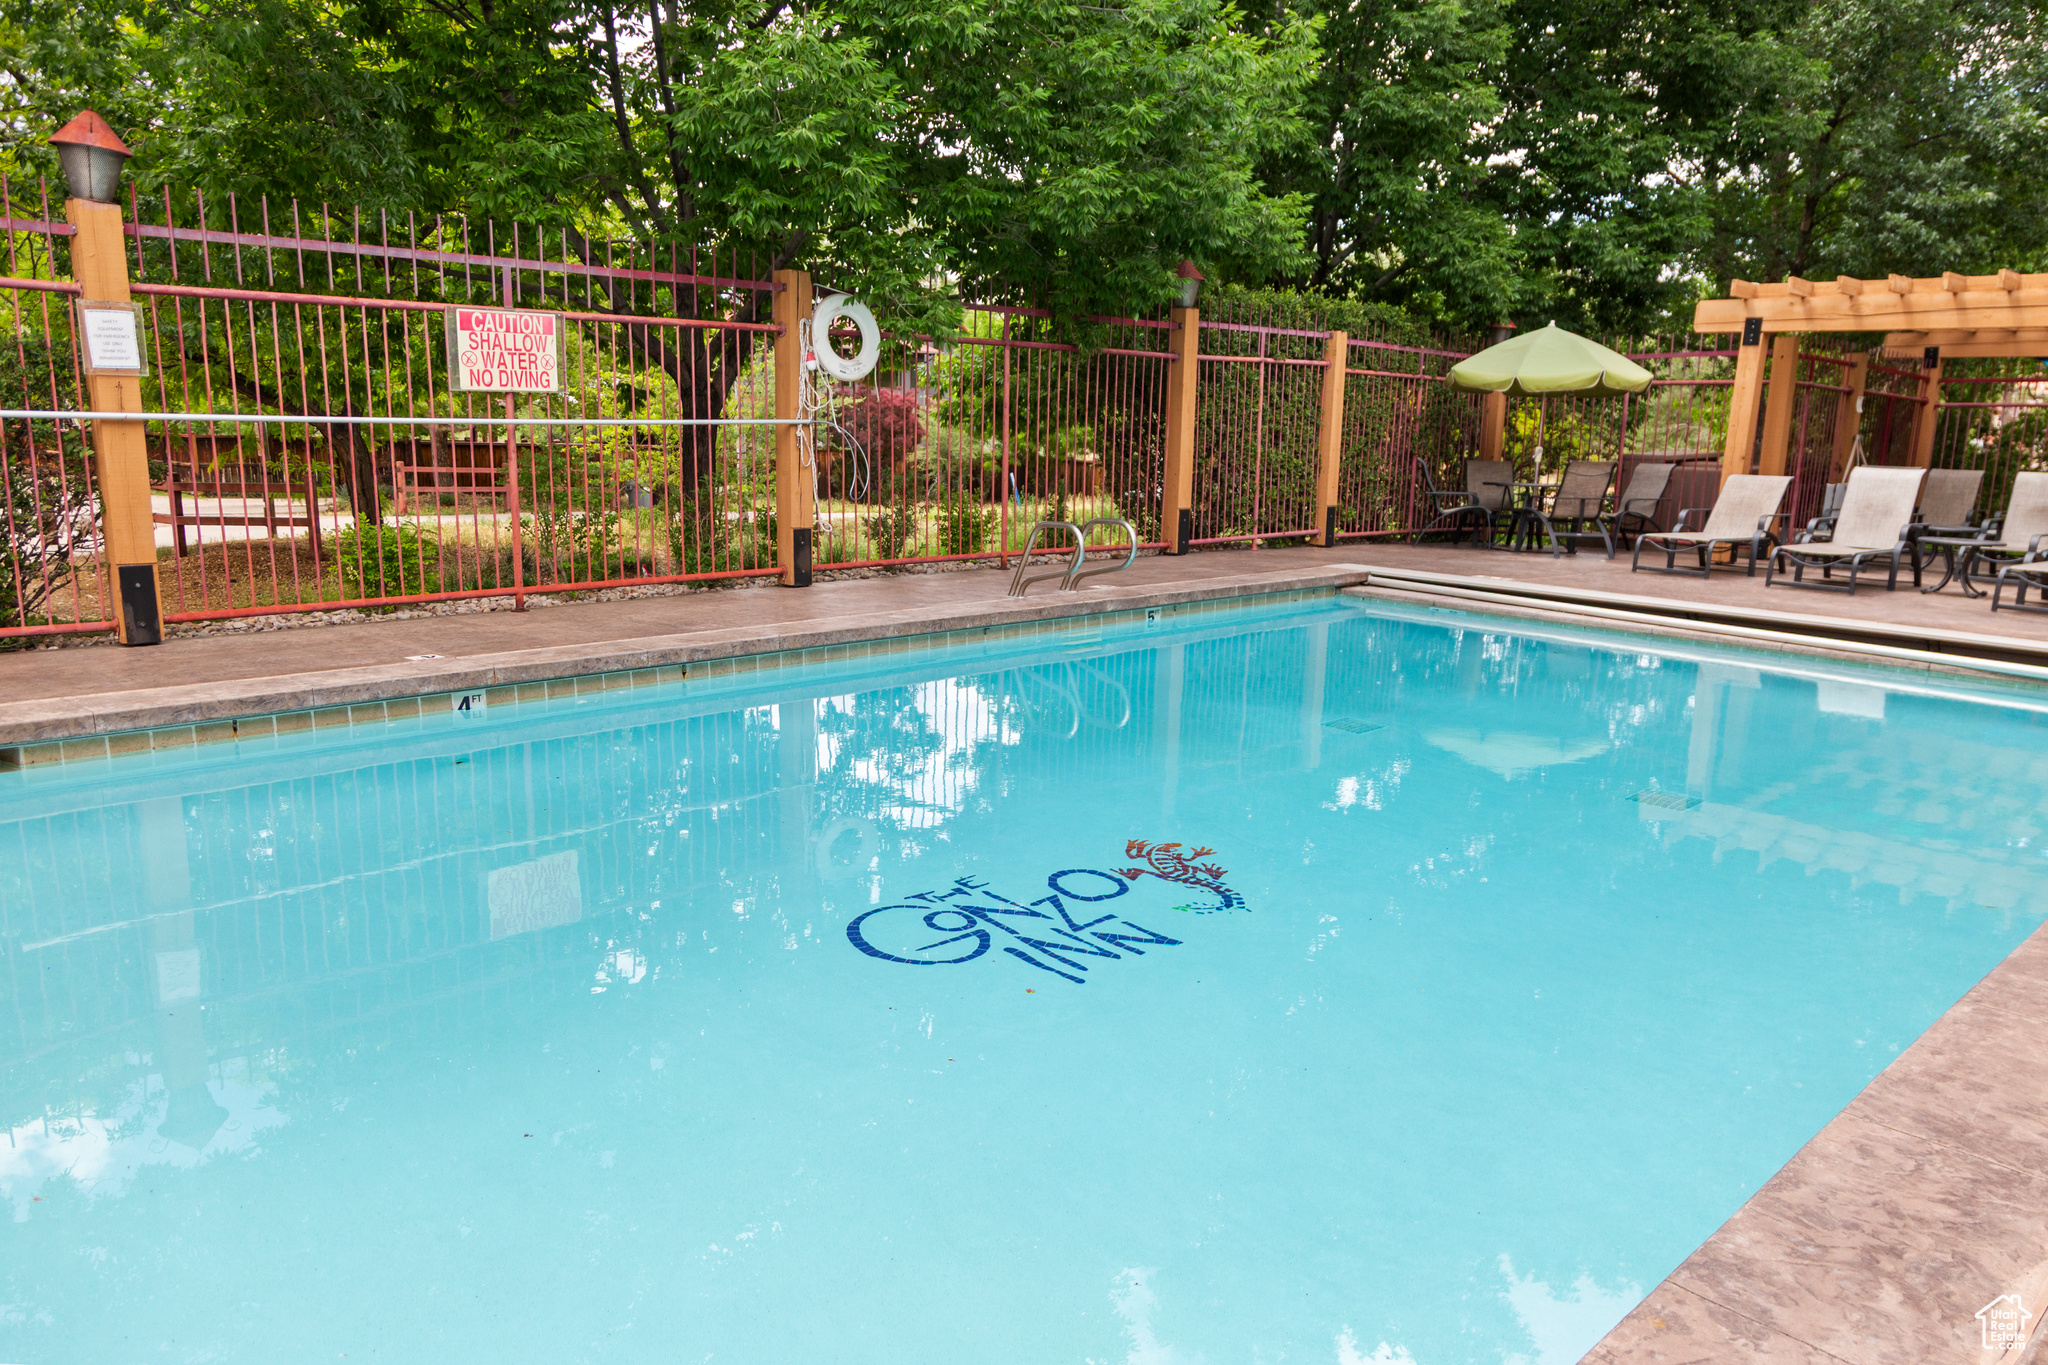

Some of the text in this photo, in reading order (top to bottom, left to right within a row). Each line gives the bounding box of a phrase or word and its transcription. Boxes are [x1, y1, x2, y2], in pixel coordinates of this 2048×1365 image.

[471, 312, 543, 334] CAUTION
[469, 332, 548, 353] SHALLOW
[481, 351, 538, 370] WATER
[469, 368, 550, 388] NO DIVING
[1148, 610, 1155, 620] 5
[846, 868, 1129, 965] GONZO
[1003, 920, 1184, 984] INN
